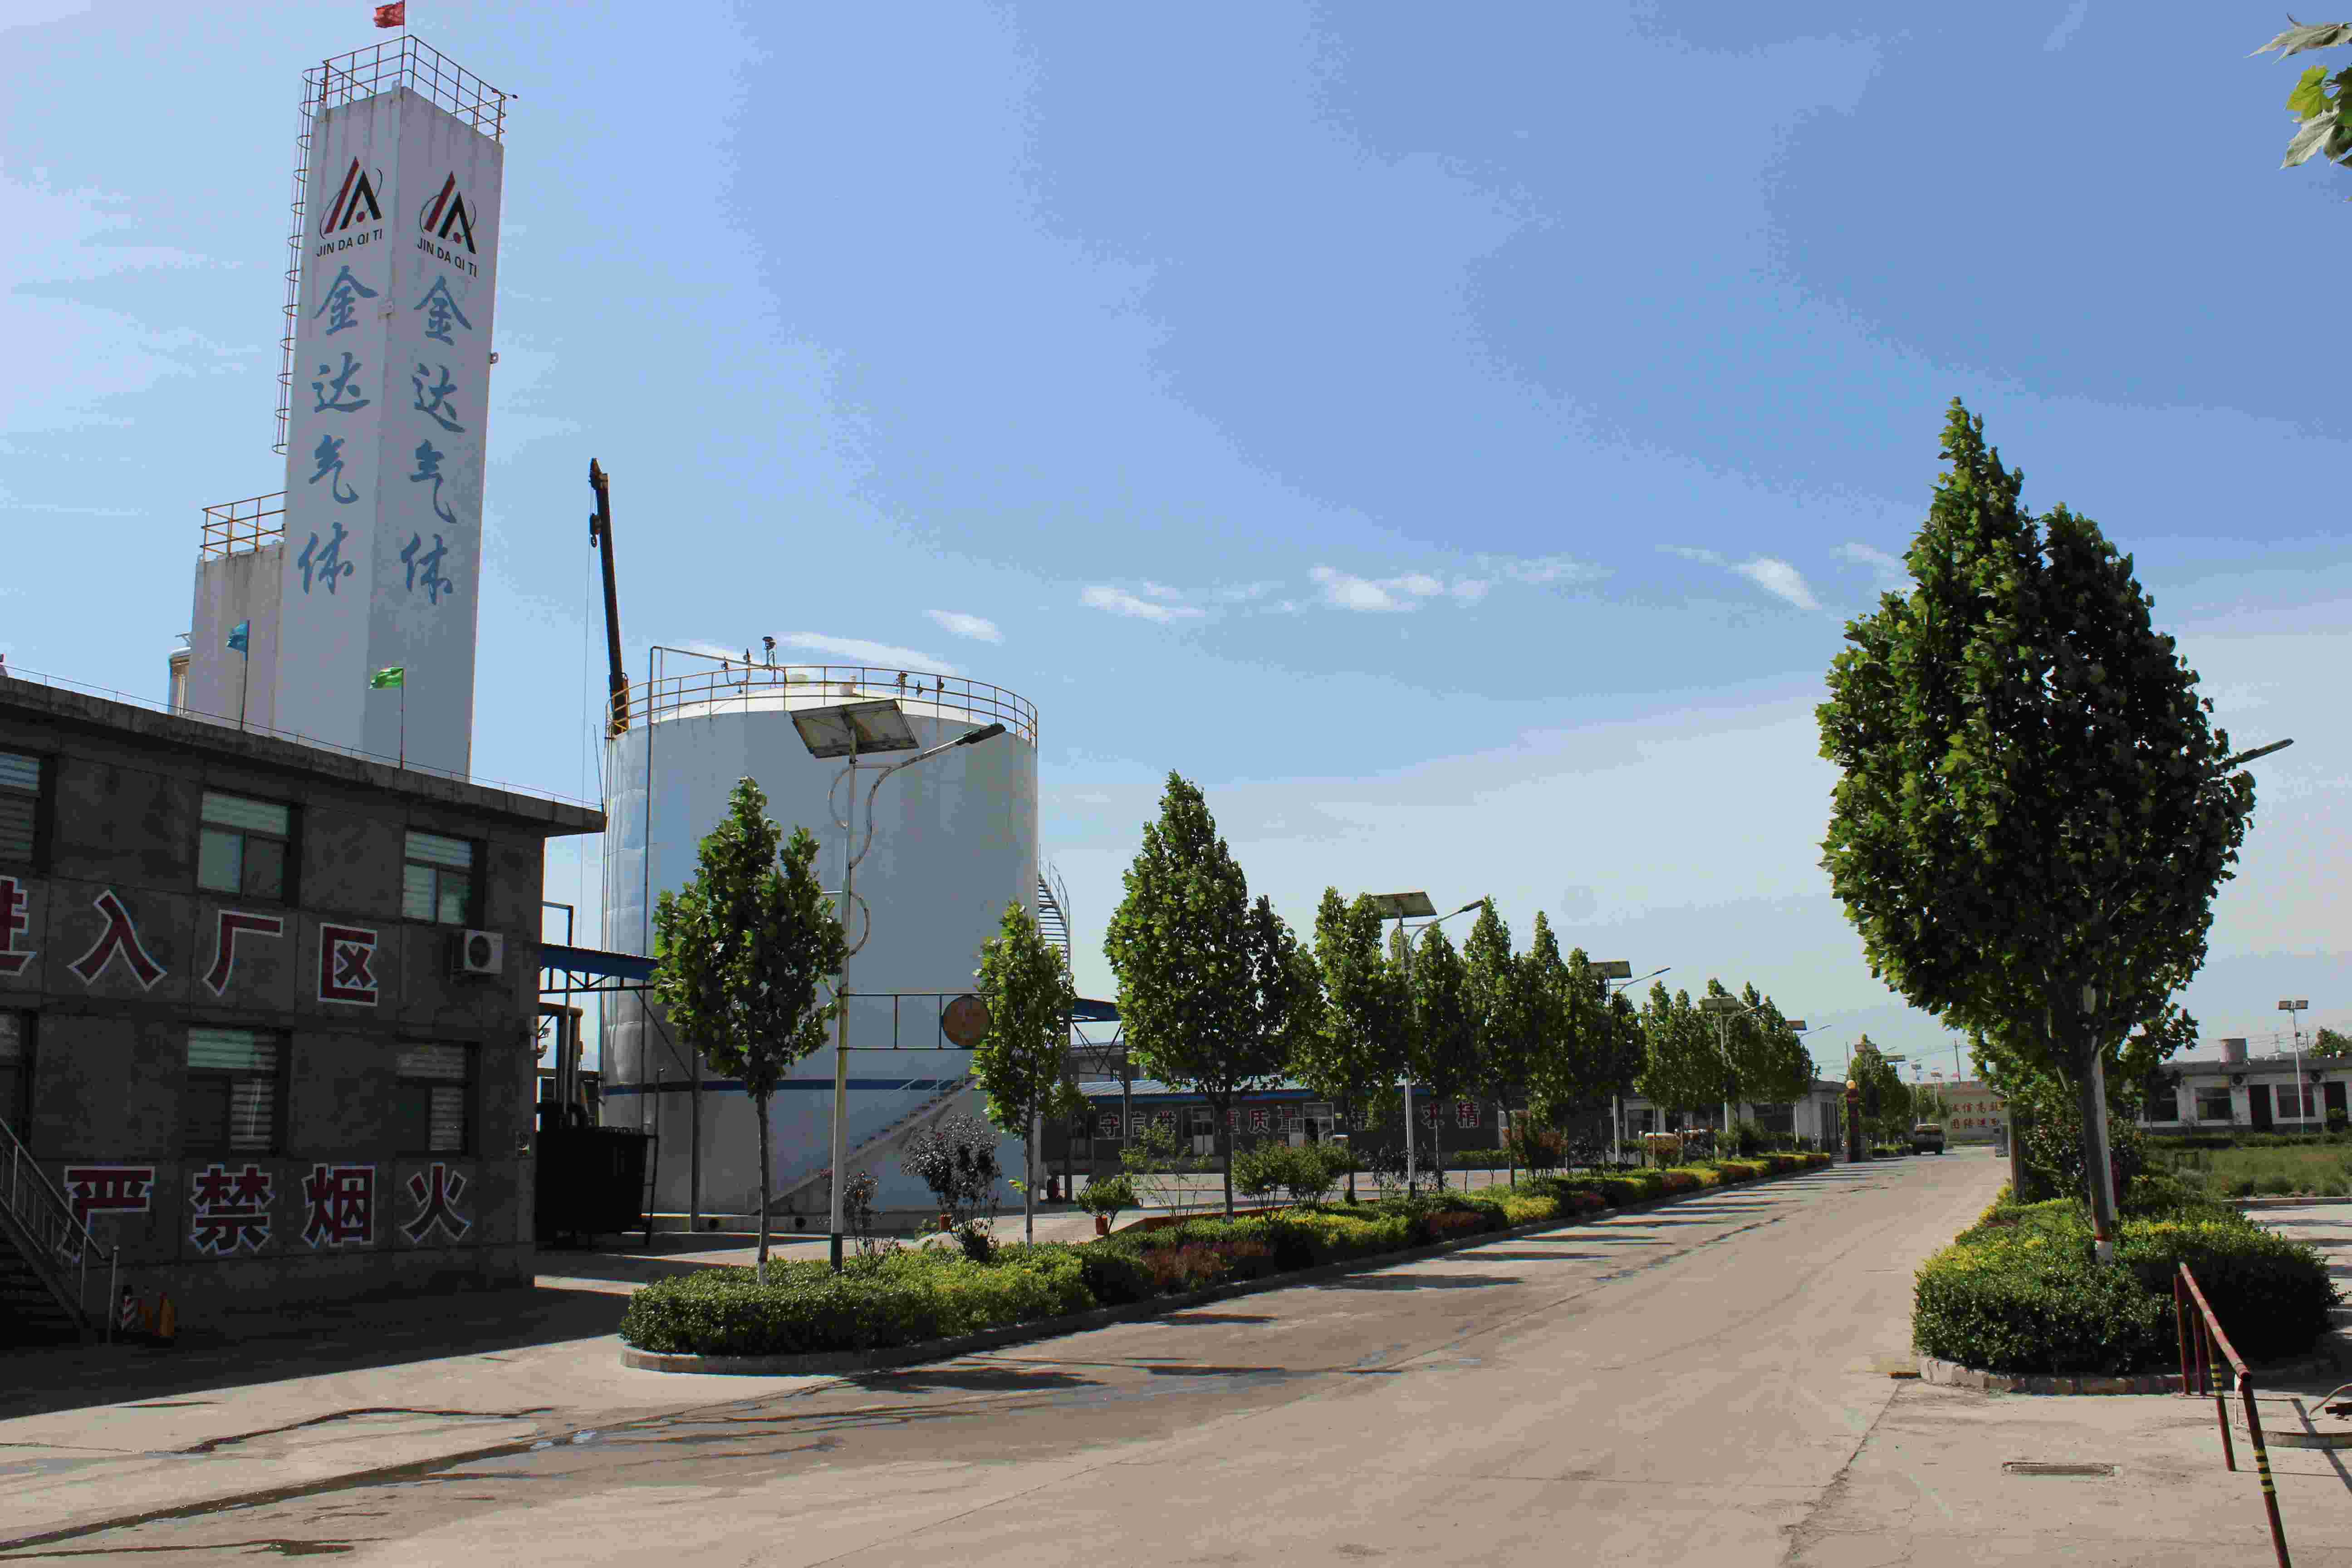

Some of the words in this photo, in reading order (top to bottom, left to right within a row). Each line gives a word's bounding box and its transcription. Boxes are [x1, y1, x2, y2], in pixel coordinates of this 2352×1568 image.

[316, 242, 334, 257] JIN
[338, 237, 353, 250] DA
[358, 232, 369, 245] QI
[373, 229, 382, 241] TI
[417, 238, 434, 255] JIN
[437, 247, 451, 264] DA
[455, 256, 465, 270] QI
[469, 262, 477, 277] TI
[297, 265, 378, 595] 金达气体
[401, 276, 472, 605] 金达气体
[57, 1163, 471, 1262] 严禁烟火
